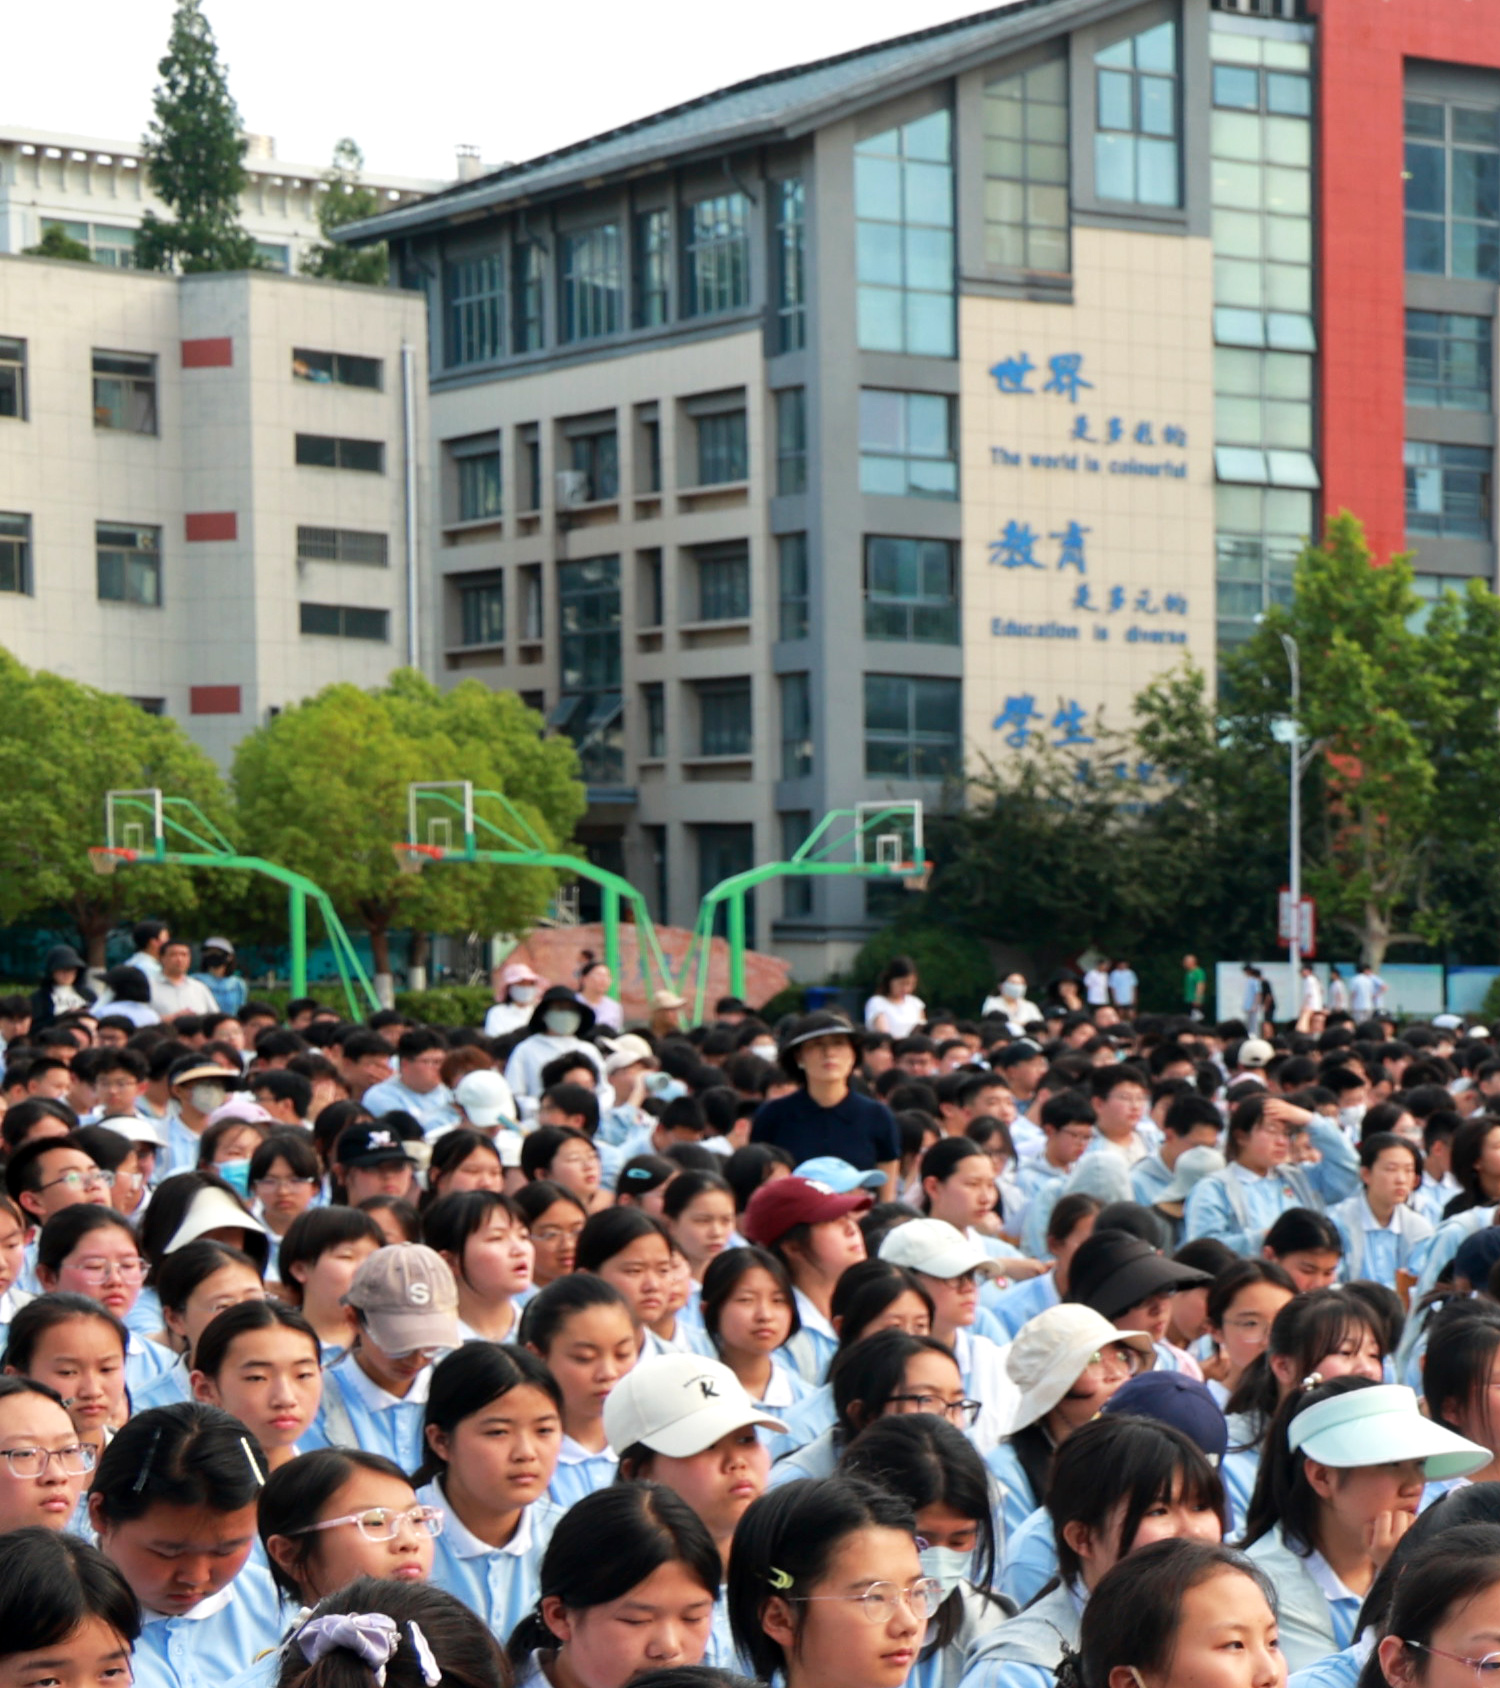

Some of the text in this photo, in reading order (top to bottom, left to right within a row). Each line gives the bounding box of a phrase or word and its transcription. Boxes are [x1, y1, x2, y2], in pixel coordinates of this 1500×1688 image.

[988, 351, 1094, 403] 世界
[991, 447, 1021, 466] The
[1029, 452, 1078, 471] world
[1084, 454, 1100, 472] is
[988, 519, 1093, 575] 教育
[1071, 582, 1188, 616] 是多元的
[991, 617, 1187, 645] Education is diverse
[409, 1282, 431, 1305] S
[700, 1381, 720, 1400] K
